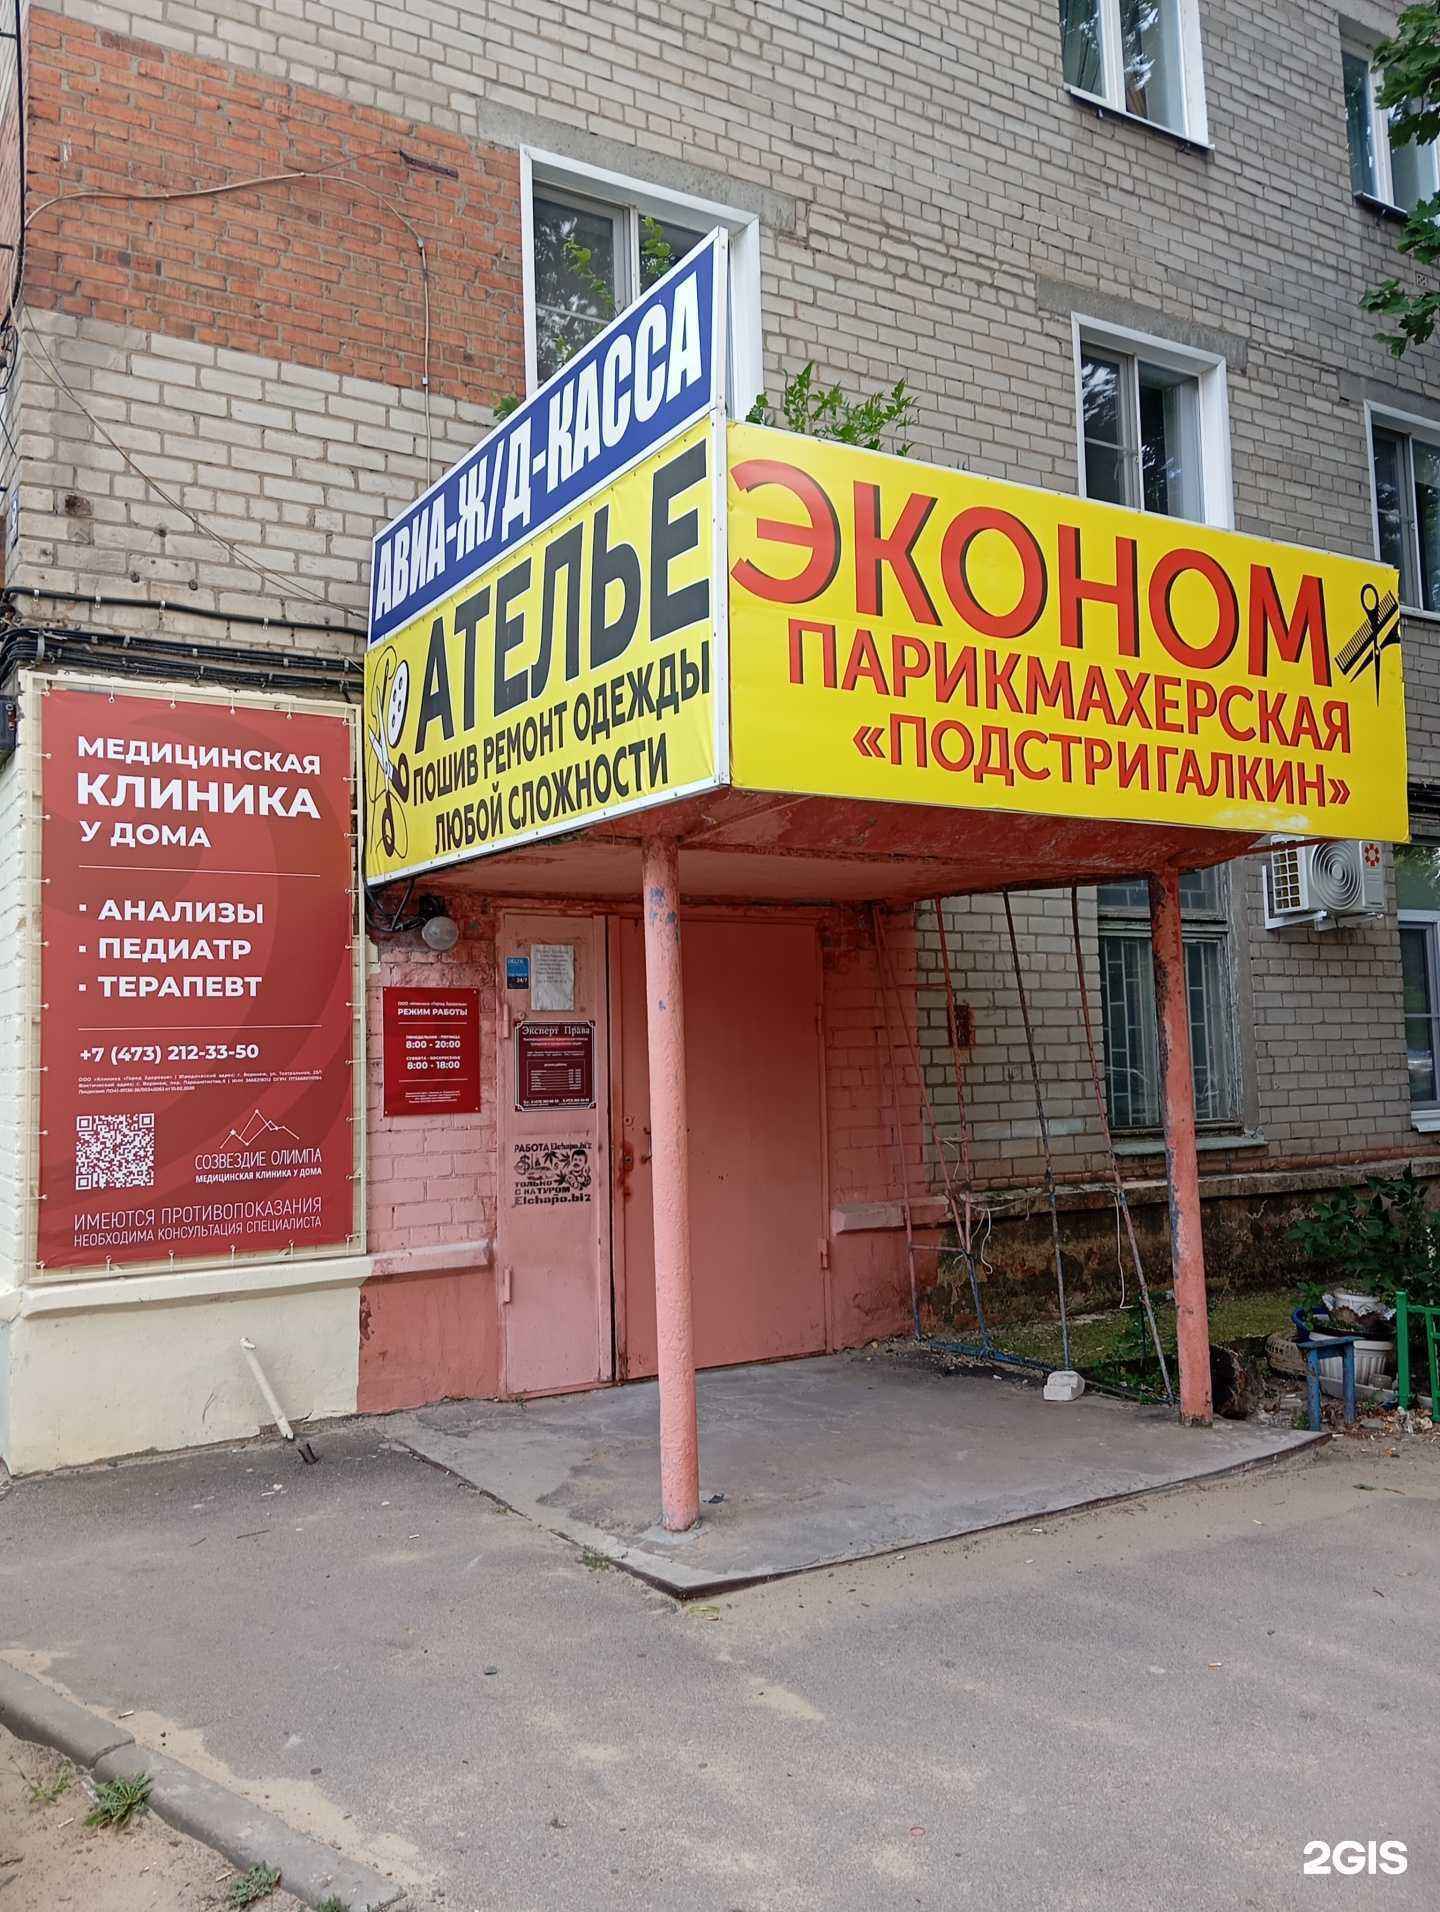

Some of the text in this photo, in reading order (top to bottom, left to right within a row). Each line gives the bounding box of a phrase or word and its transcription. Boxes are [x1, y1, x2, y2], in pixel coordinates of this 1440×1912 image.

[375, 270, 703, 622] АВИА-Ж/Д-КАССА
[731, 459, 1331, 687] ЭКОНОМ
[415, 438, 710, 753] АТЕЛЬЕ
[787, 618, 1351, 754] ПАРИКМАХЕРСКАЯ
[413, 642, 710, 806] ПОШИВ РЕМОНТ ОДЕЖДЫ
[78, 736, 321, 775] МЕДИЦИНСКАЯ
[853, 713, 1351, 808] «ПОДСТРИГАЛКИН»
[77, 773, 321, 819] КЛИНИКА
[435, 733, 668, 854] ЛЮБОЙ СЛОЖНОСТИ
[80, 821, 211, 848] У ДОМА
[98, 900, 264, 924] АНАЛИЗЫ
[98, 938, 252, 962] ПЕДИАТР
[98, 976, 262, 998] ТЕРАПЕВТ
[397, 1008, 467, 1016] РЕЖИМ РАБОТЫ
[405, 1040, 427, 1048] 8:00
[434, 1040, 461, 1048] 20:00
[522, 1026, 590, 1037] Эксперт Права
[80, 1044, 259, 1065] +7 (473) 212-33-50
[436, 1061, 460, 1069] 18:00
[195, 1147, 322, 1170] СОЗВЕЗДИЕ ОЛИМПА
[514, 1143, 550, 1153] РАБОТА
[195, 1167, 322, 1184] МЕДИЦИНСКАЯ КЛИНИКА У ДОМА
[74, 1197, 322, 1231] ИМЕЮТСЯ ПРОТИВОПОКАЗАНИЯ
[74, 1216, 322, 1247] НЕОБХОДИМА КОНСУЛЬТАЦИЯ СПЕЦИАЛИСТА
